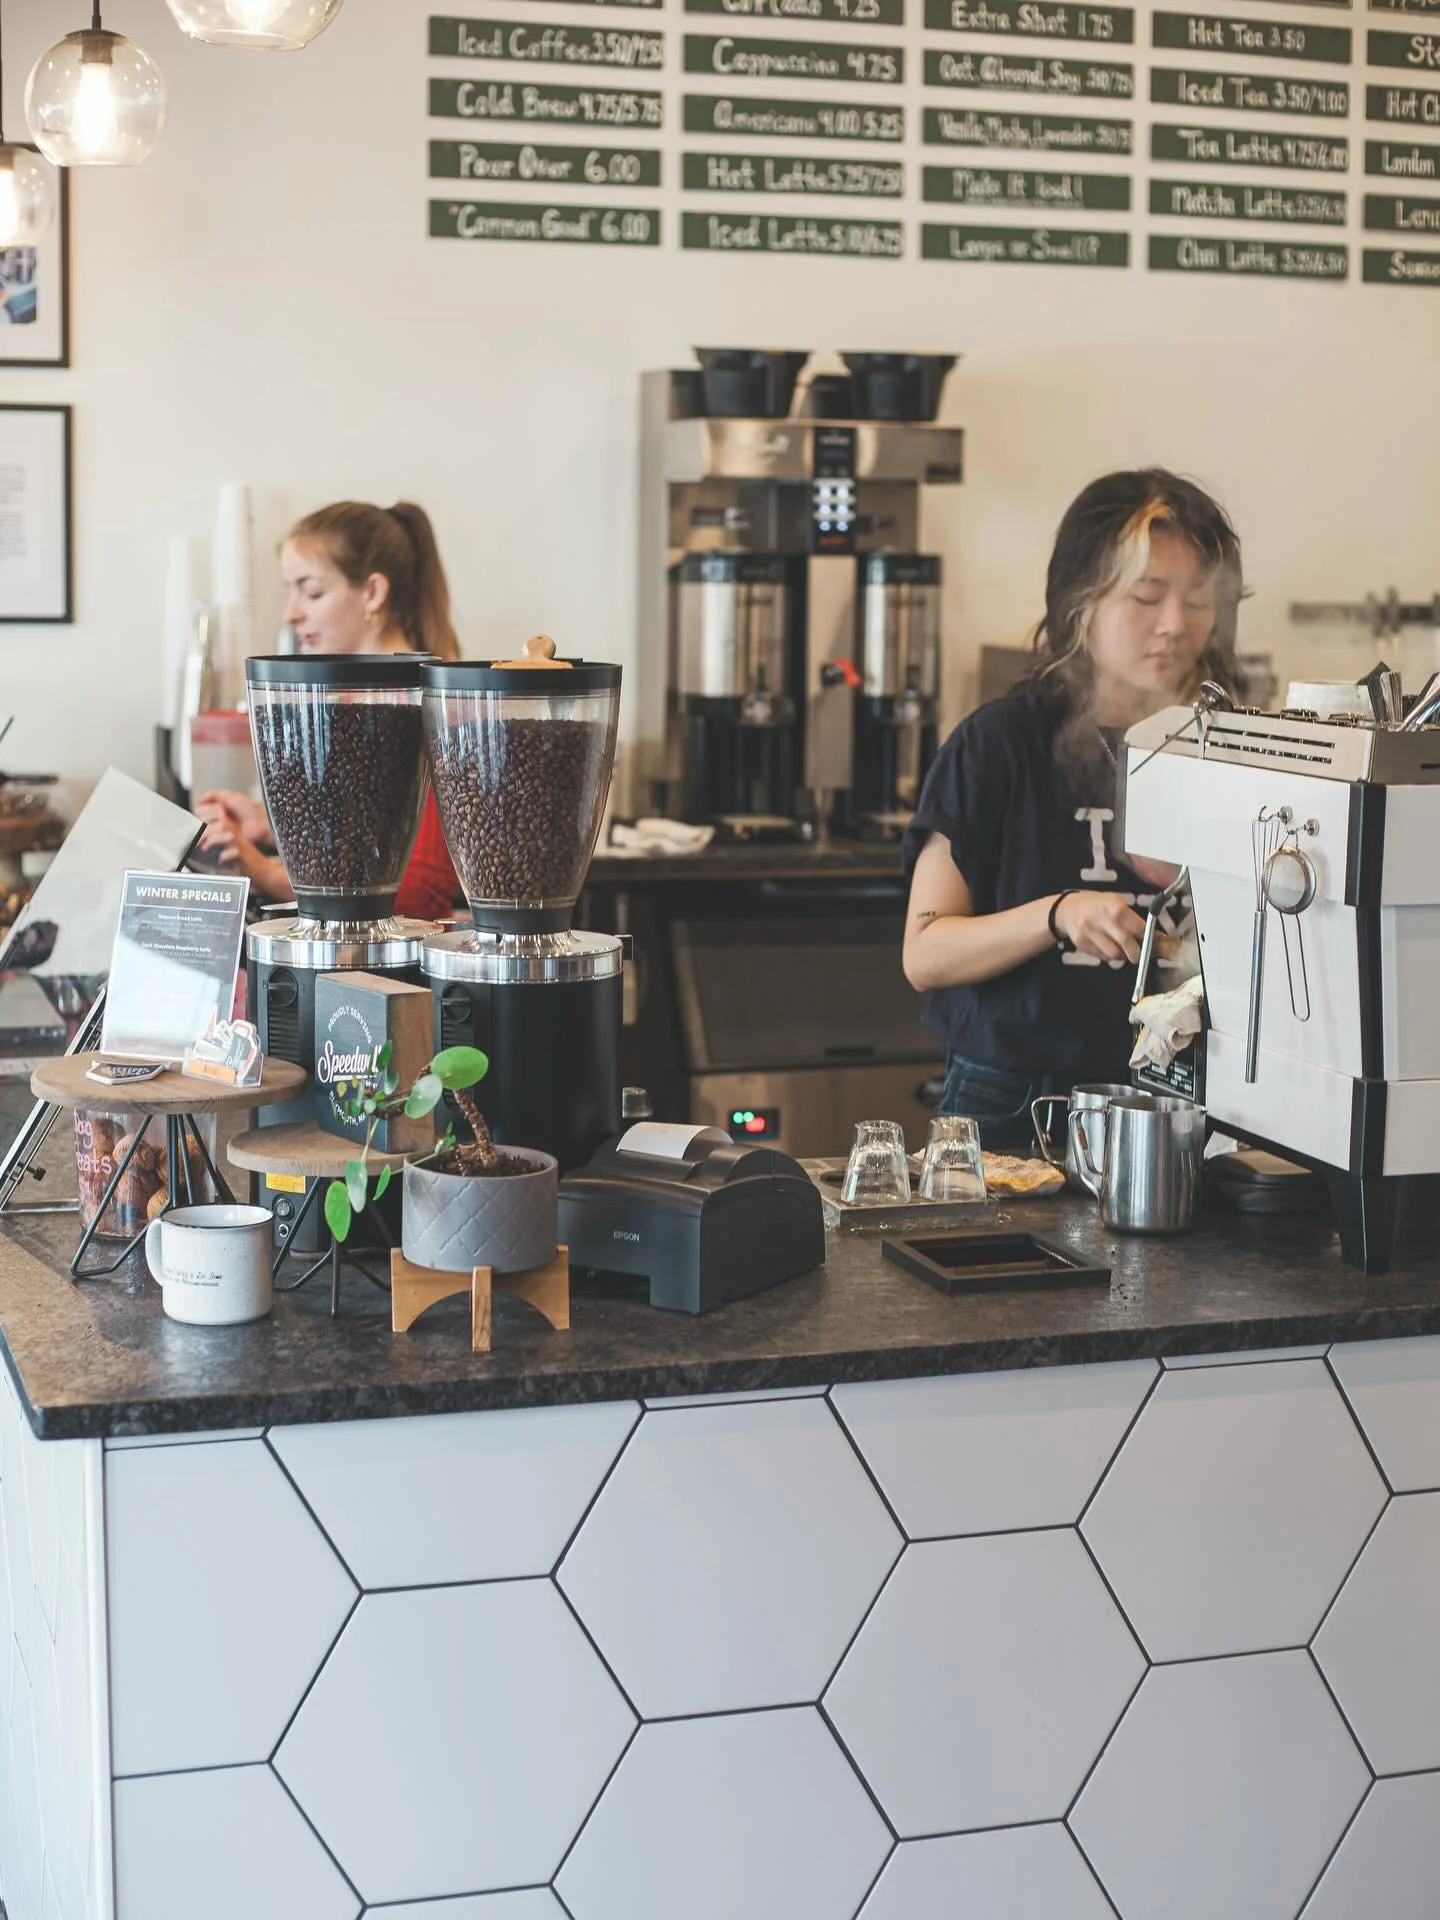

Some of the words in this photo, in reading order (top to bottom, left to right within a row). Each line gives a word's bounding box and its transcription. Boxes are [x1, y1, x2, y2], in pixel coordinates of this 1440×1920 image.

[951, 0, 1011, 30] Extra
[1016, 4, 1068, 35] Shot
[1188, 18, 1224, 46] Hot
[1230, 23, 1264, 48] Tea
[458, 23, 503, 56] Iced
[508, 27, 591, 61] Coffee
[847, 52, 897, 81] 4.75
[456, 82, 515, 116] Cold
[522, 86, 578, 118] Brew
[1178, 72, 1224, 104] Iced
[1228, 77, 1270, 107] Tea
[1386, 90, 1418, 119] Hot
[1177, 129, 1220, 160] Tea
[1226, 132, 1283, 163] Latte
[458, 143, 515, 178] Pour
[518, 145, 573, 180] Over
[583, 149, 642, 184] 6.00
[707, 156, 755, 189] Hot
[764, 158, 830, 192] Latte
[1171, 186, 1236, 216] Matcha
[1244, 188, 1295, 218] Latte
[708, 215, 762, 248] Iced
[767, 218, 829, 251] Latte
[1226, 239, 1277, 272] Latte
[136, 886, 178, 899] WINTER
[181, 889, 231, 903] SPECIALS
[328, 1006, 350, 1032] PROUDLY
[350, 1008, 372, 1044] SERVING
[76, 1148, 112, 1175] eats
[613, 1230, 640, 1243] EPSON
